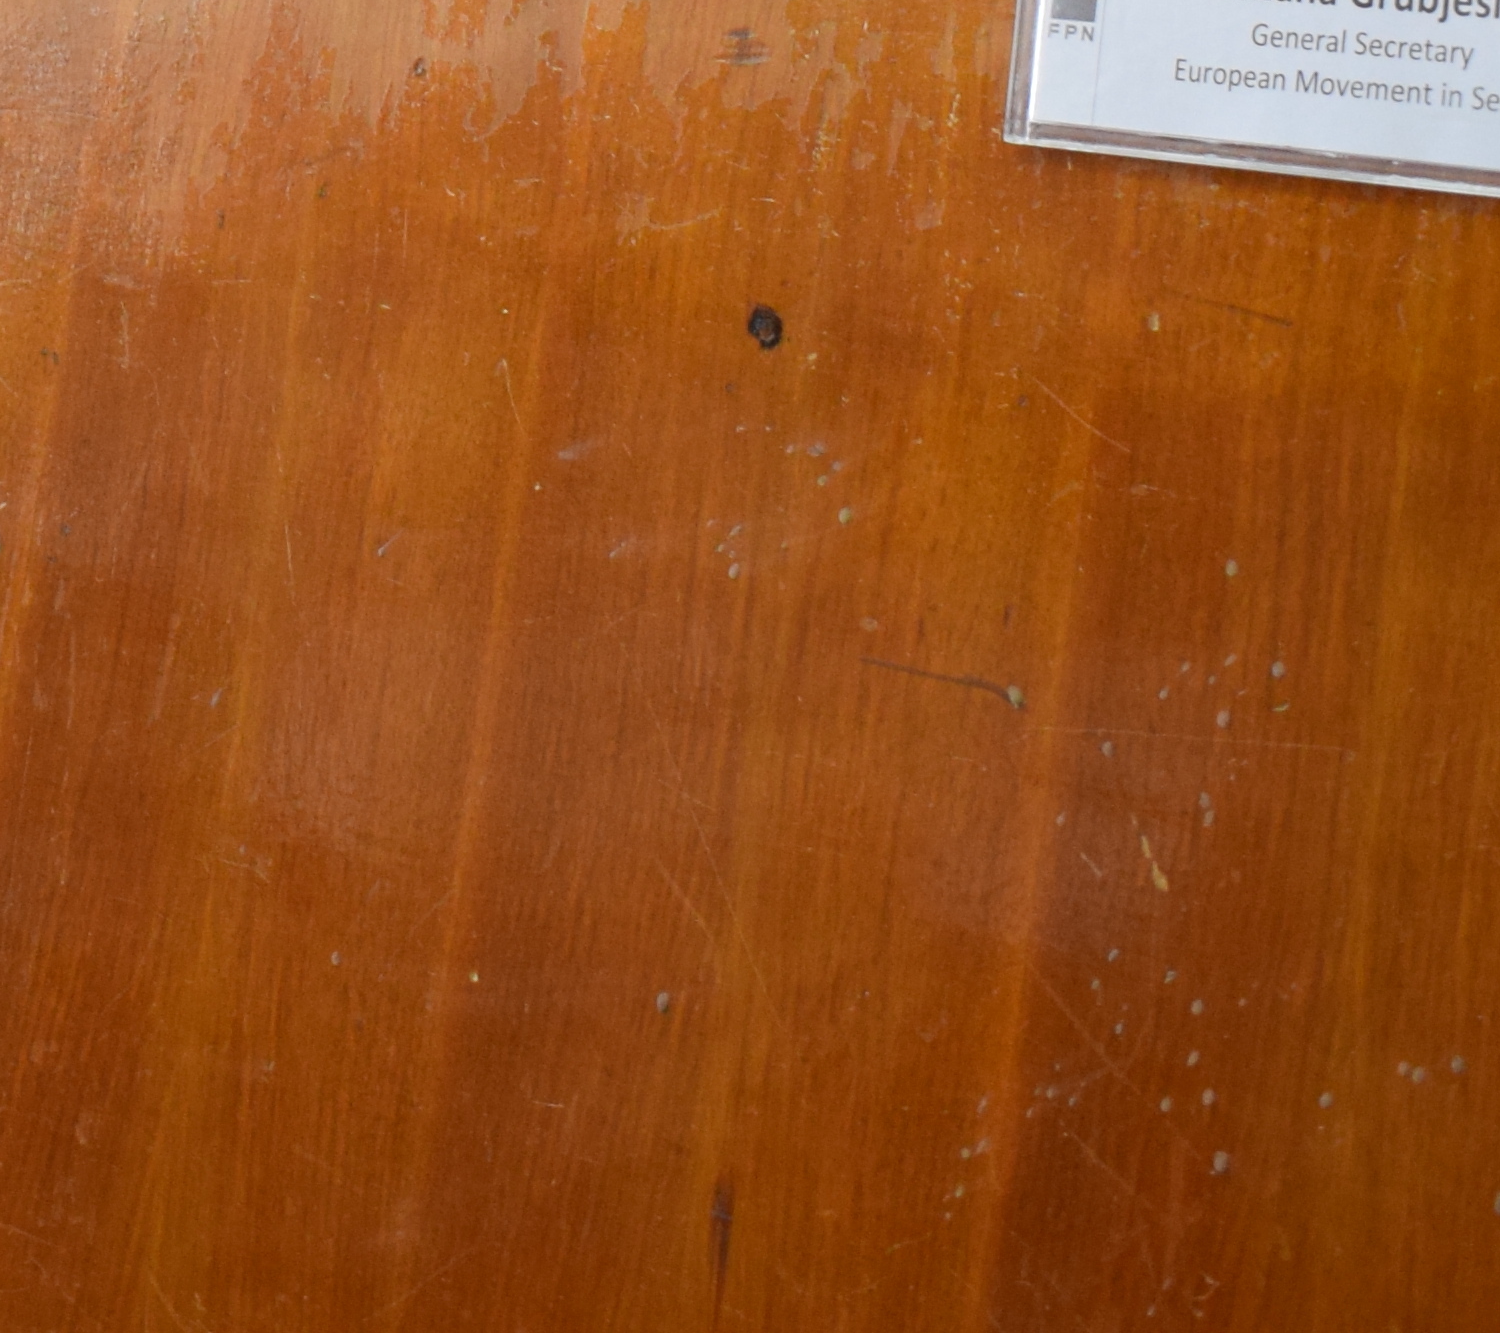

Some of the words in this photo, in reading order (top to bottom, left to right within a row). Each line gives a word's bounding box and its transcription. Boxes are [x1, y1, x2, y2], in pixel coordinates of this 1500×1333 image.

[1047, 22, 1095, 42] FPN
[1251, 22, 1347, 54] General
[1354, 31, 1474, 71] Secretary
[1174, 58, 1286, 92] European
[1295, 70, 1433, 107] Movement
[1441, 82, 1463, 109] in
